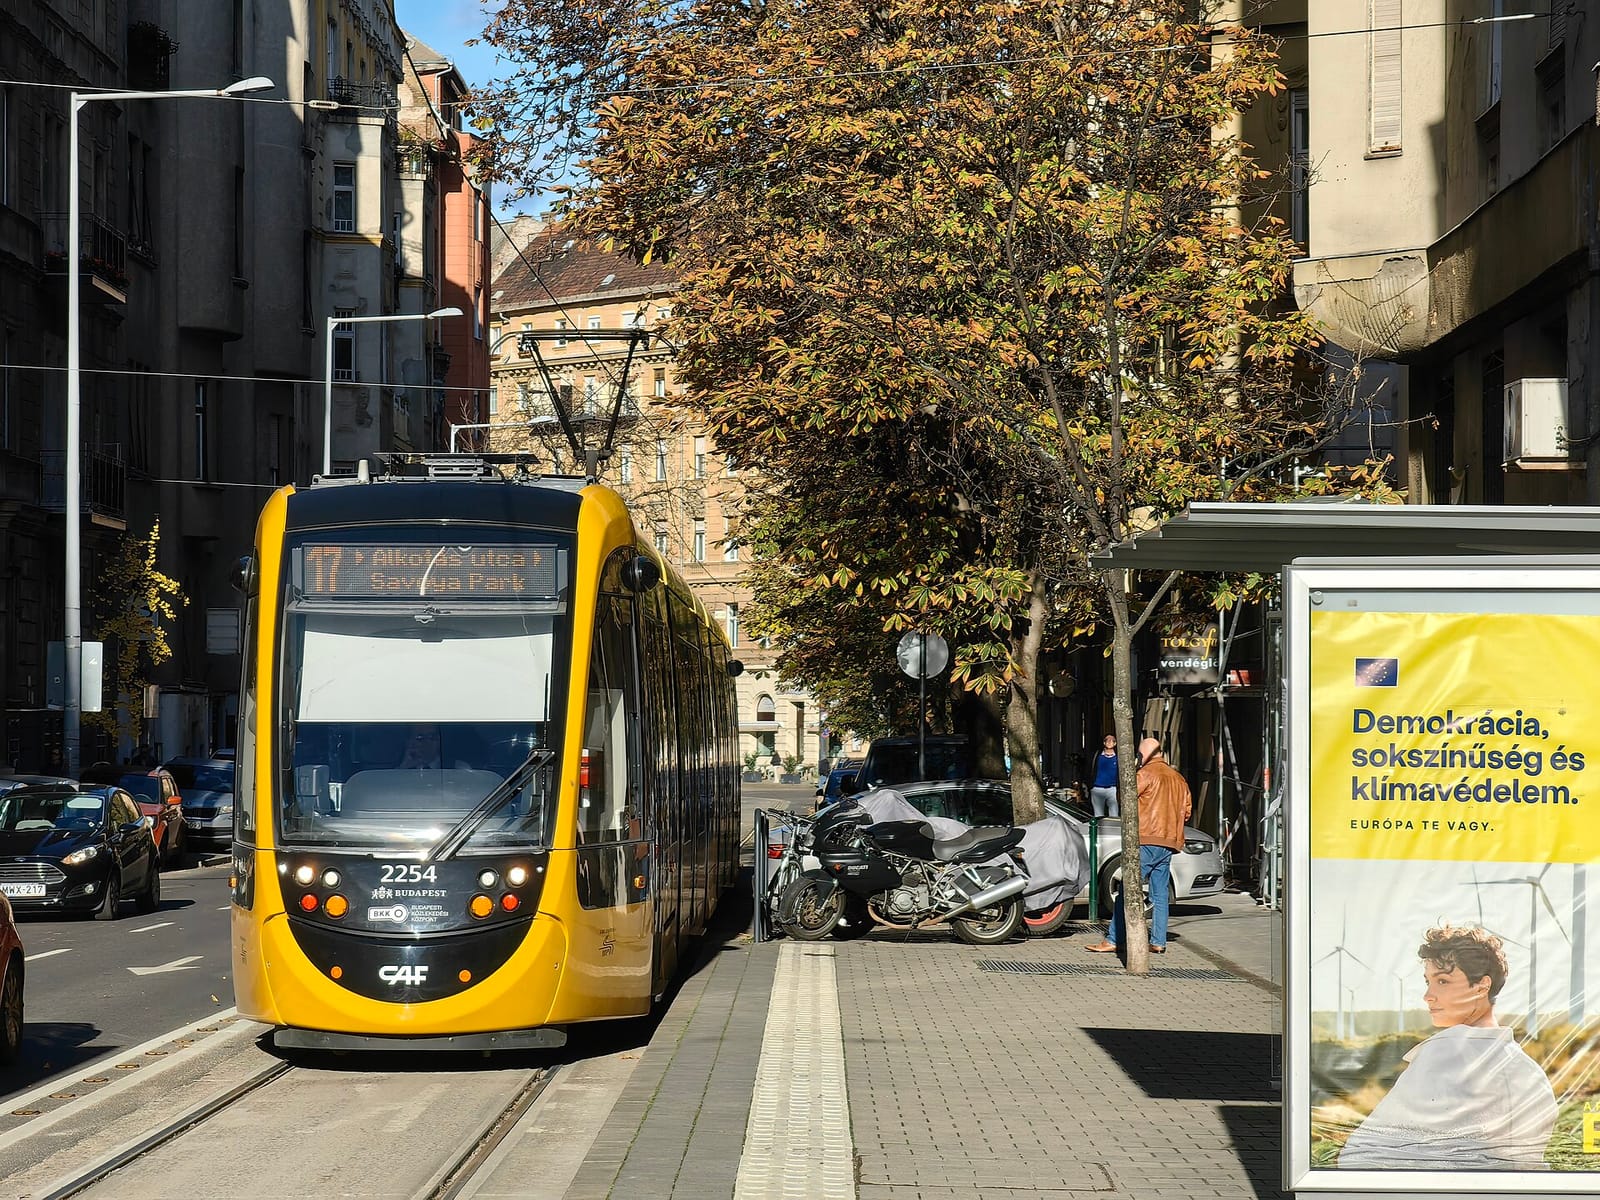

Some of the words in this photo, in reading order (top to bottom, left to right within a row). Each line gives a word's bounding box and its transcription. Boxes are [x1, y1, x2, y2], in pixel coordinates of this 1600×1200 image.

[471, 549, 525, 567] utca
[306, 546, 342, 592] 17
[371, 573, 461, 592] Savoya
[469, 573, 525, 590] Park
[1353, 708, 1549, 740] Demokrácia,
[1351, 742, 1543, 776] sokszínűség
[1550, 745, 1585, 771] és
[1351, 775, 1579, 805] klímavédelem.
[1350, 817, 1414, 830] EURÓPA
[1422, 821, 1440, 830] TE
[1447, 821, 1494, 832] VAGY.
[380, 865, 437, 883] 2254
[2, 885, 43, 894] MWX-217
[395, 889, 447, 897] BUDAPEST
[379, 965, 429, 985] CAF
